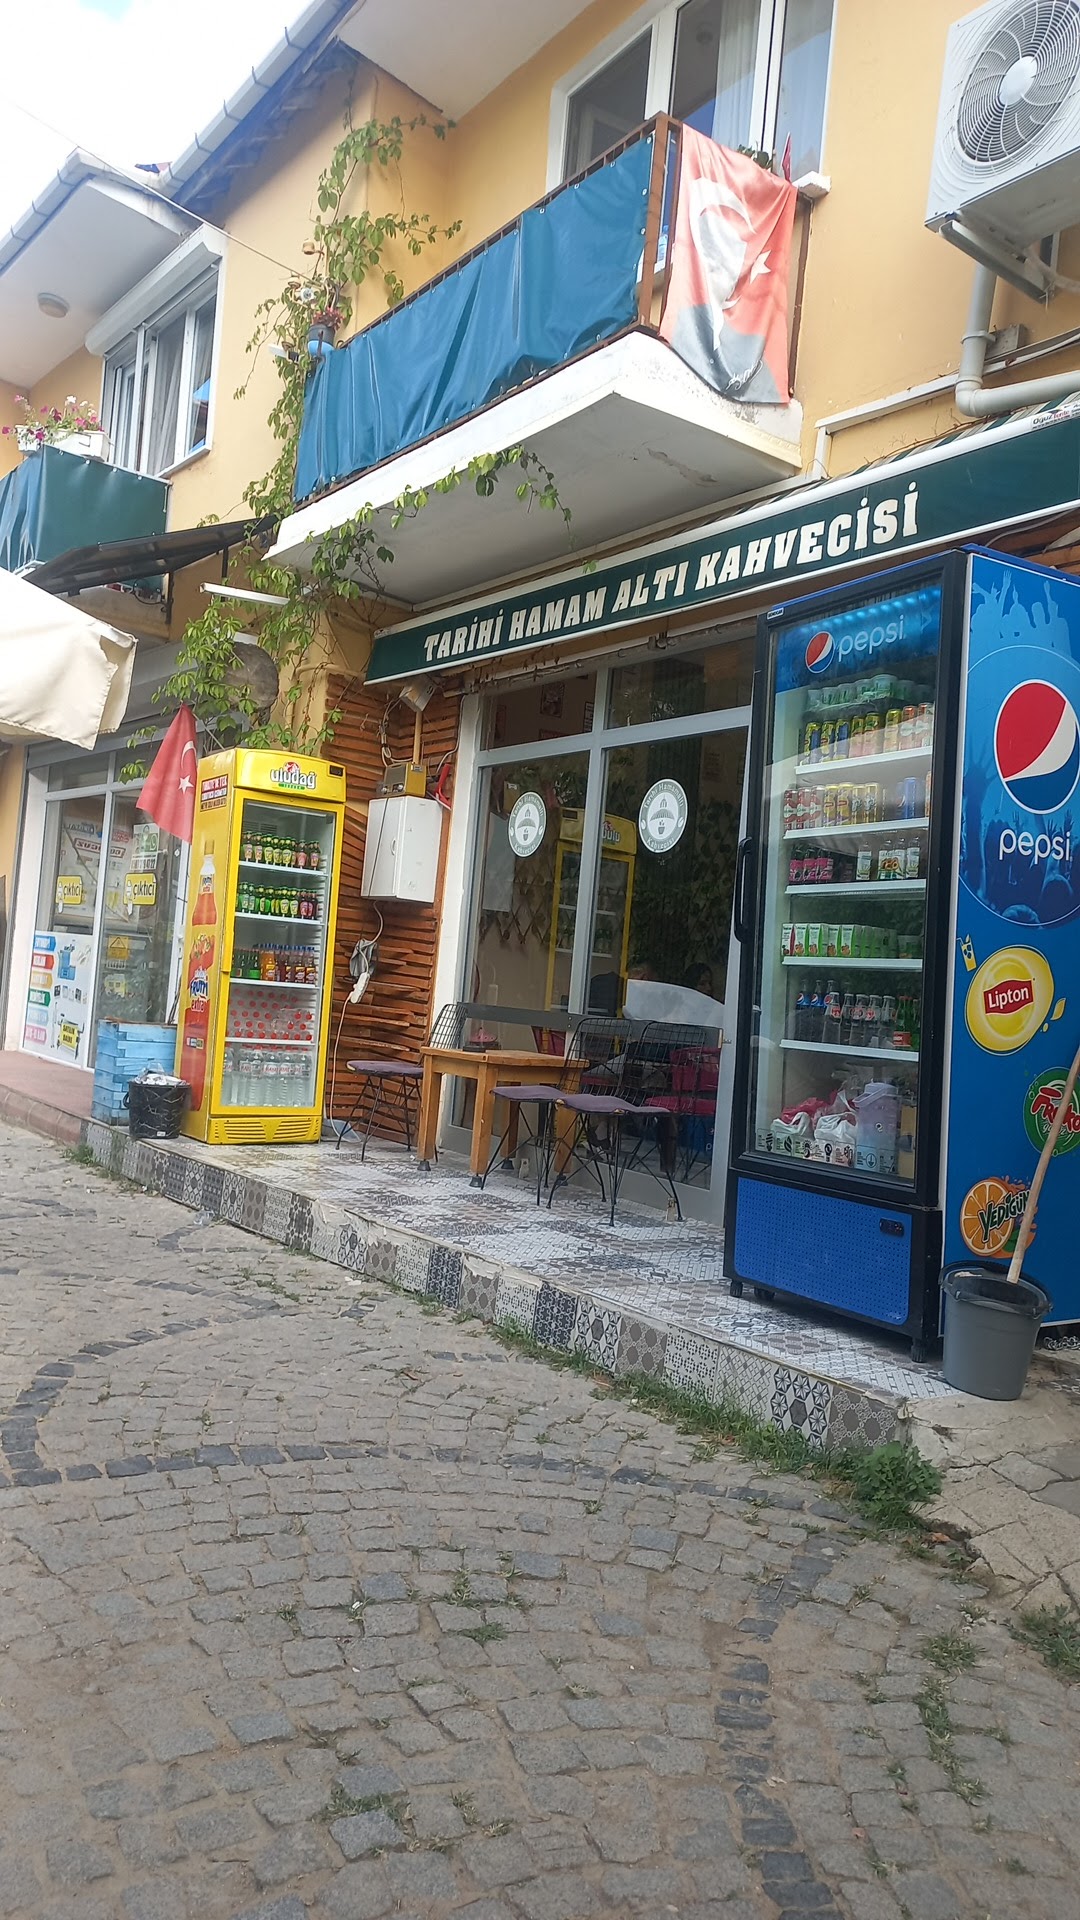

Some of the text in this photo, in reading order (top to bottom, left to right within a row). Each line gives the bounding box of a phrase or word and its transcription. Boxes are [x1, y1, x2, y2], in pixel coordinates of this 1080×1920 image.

[424, 481, 919, 662] TARİHİ HAMAM ALTI KAHVECİSİ
[838, 614, 904, 662] pepsi
[270, 765, 317, 790] uludağ
[999, 828, 1070, 865] pepsi
[988, 987, 1029, 1010] Lipton
